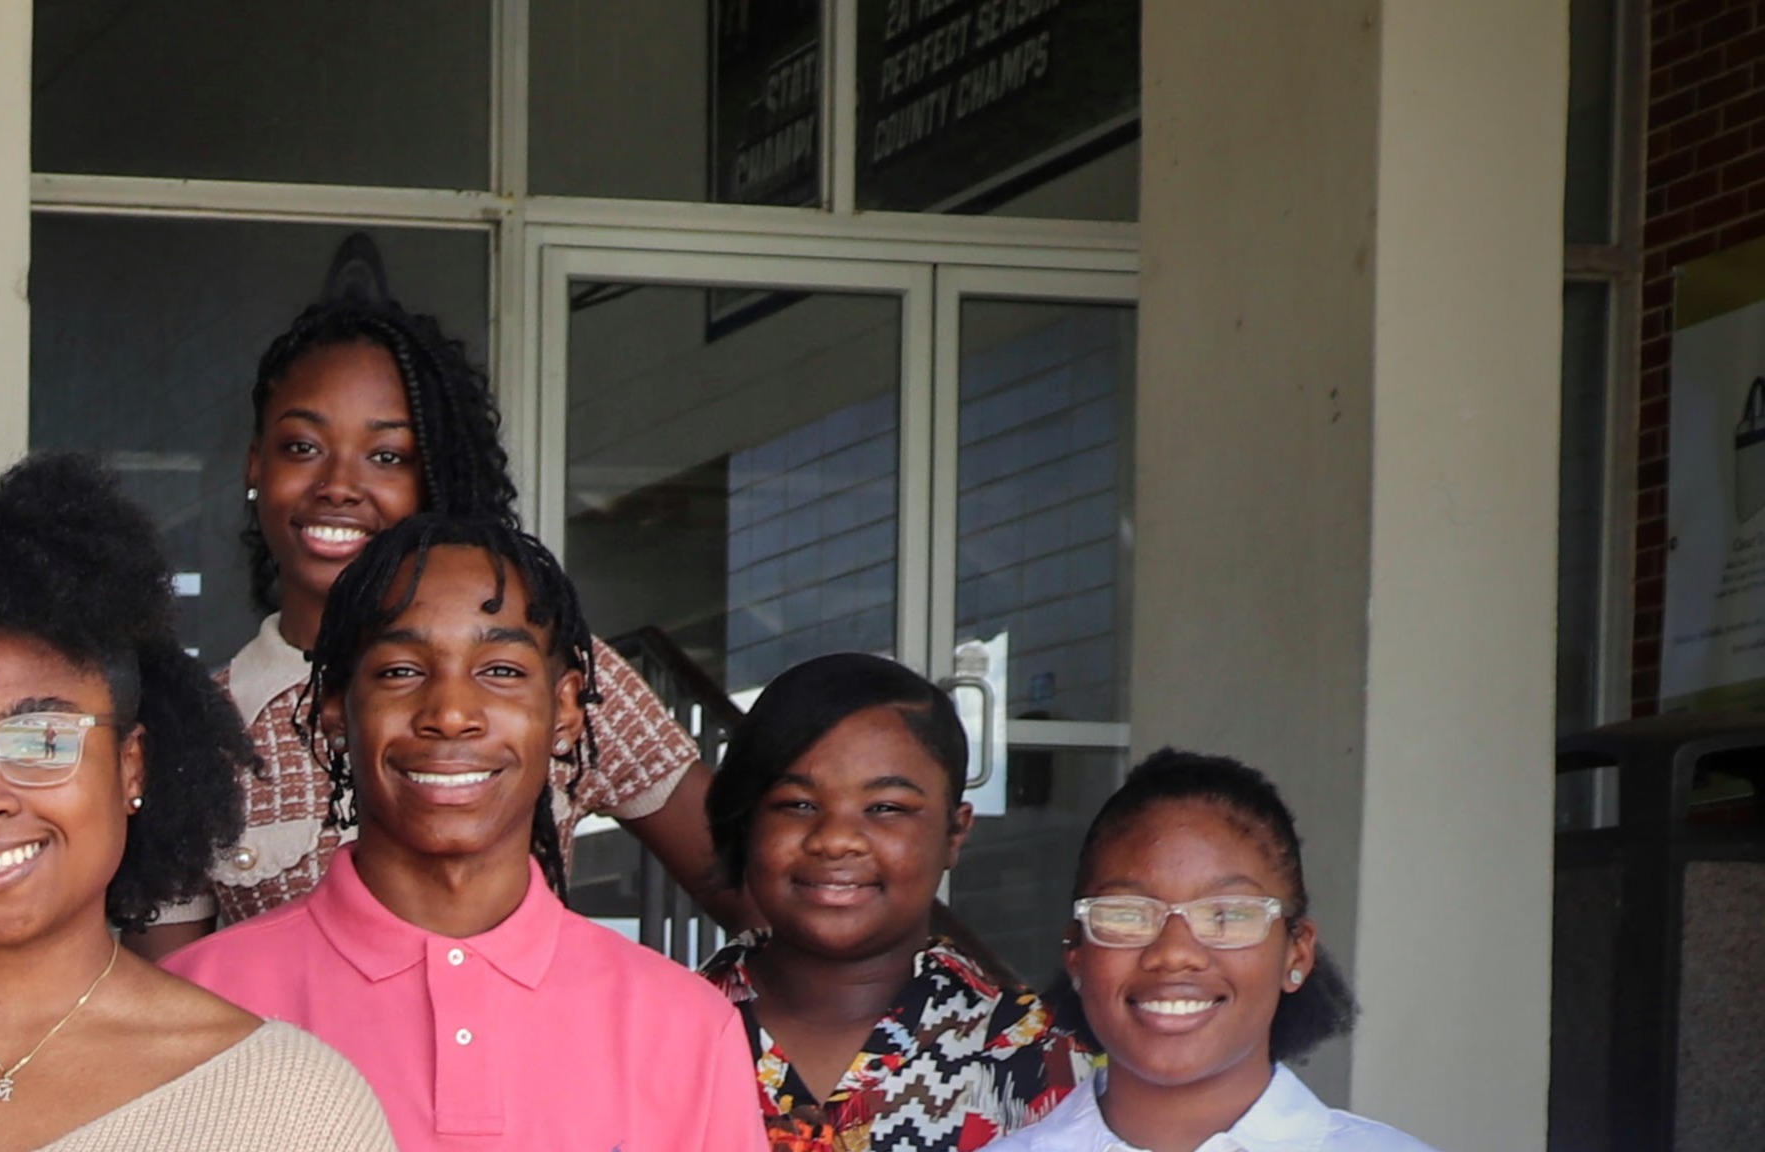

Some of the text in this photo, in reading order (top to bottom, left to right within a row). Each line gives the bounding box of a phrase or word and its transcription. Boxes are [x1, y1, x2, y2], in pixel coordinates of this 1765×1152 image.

[872, 30, 1050, 163] COUNTY CHAMPS
[878, 12, 973, 103] PERFECT
